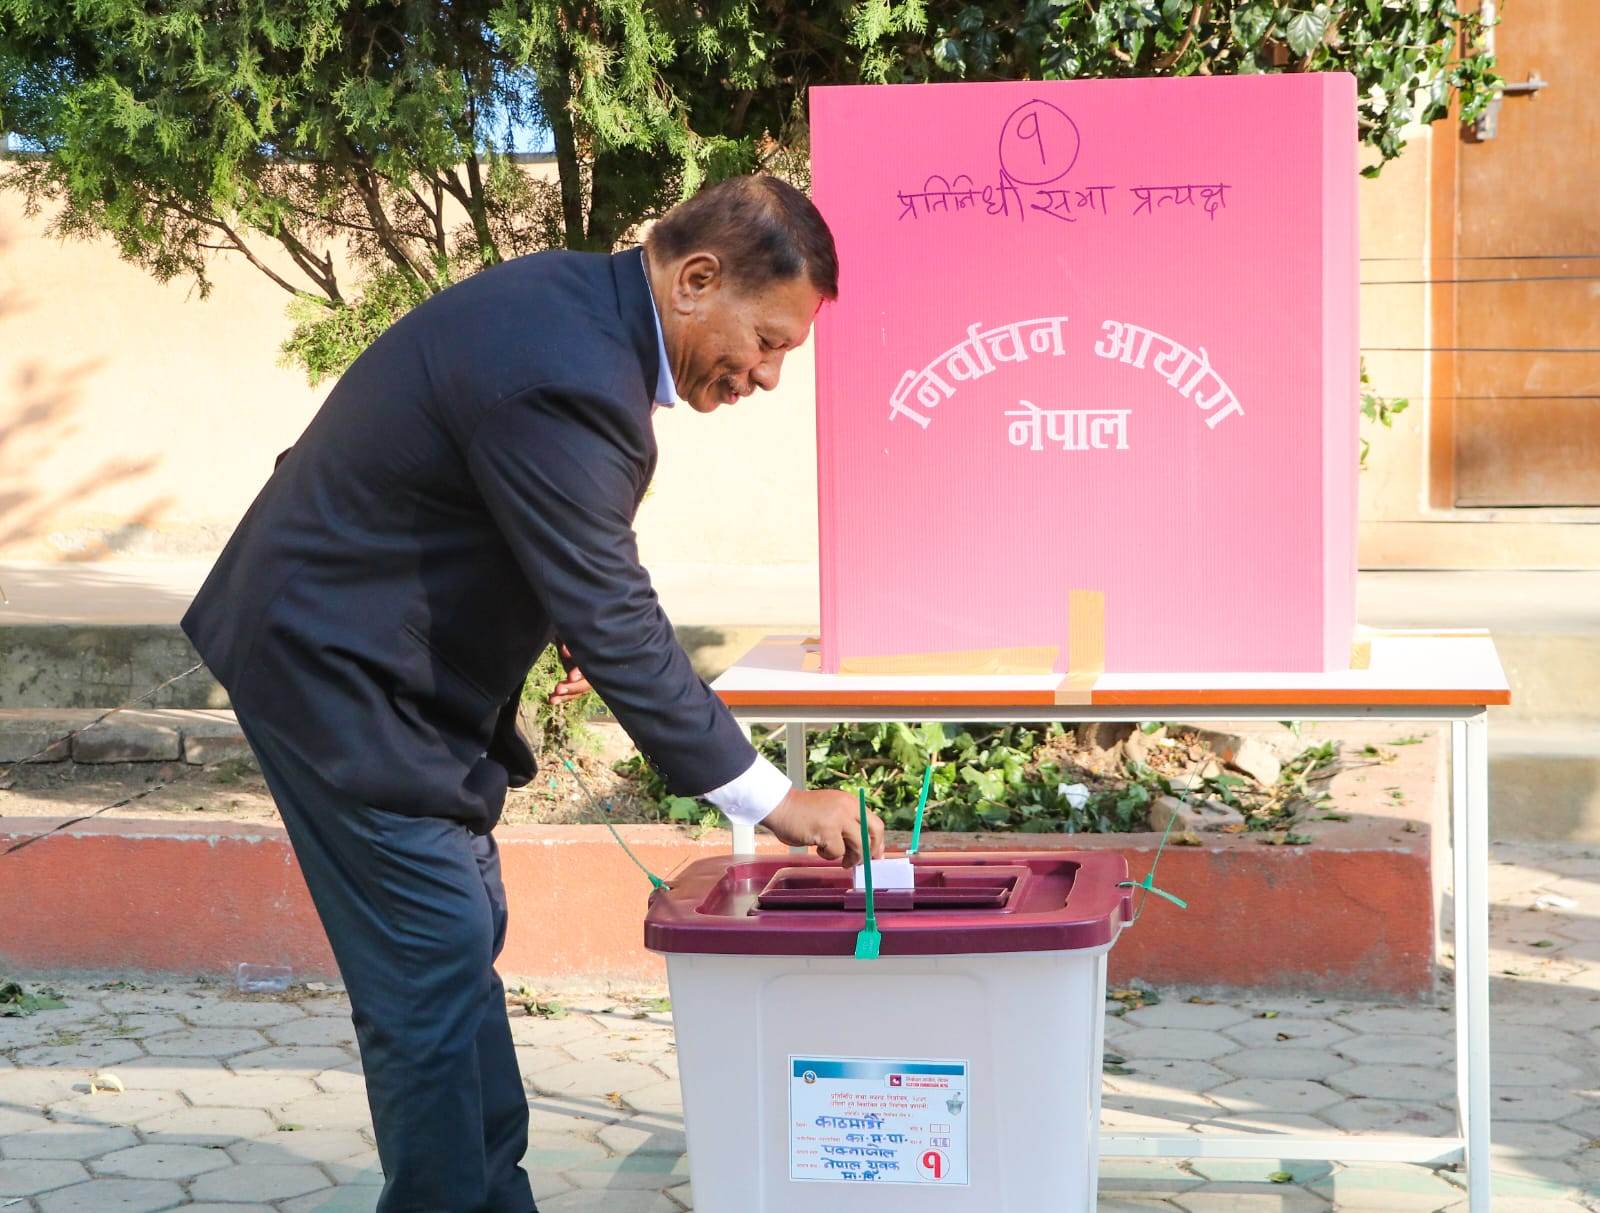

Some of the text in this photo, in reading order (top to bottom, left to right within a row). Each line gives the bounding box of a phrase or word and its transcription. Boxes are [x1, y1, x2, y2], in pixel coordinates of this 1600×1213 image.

[888, 316, 1245, 430] निर्वाचन आयोग
[1004, 399, 1132, 451] नेपाल
[921, 1151, 942, 1180] १
